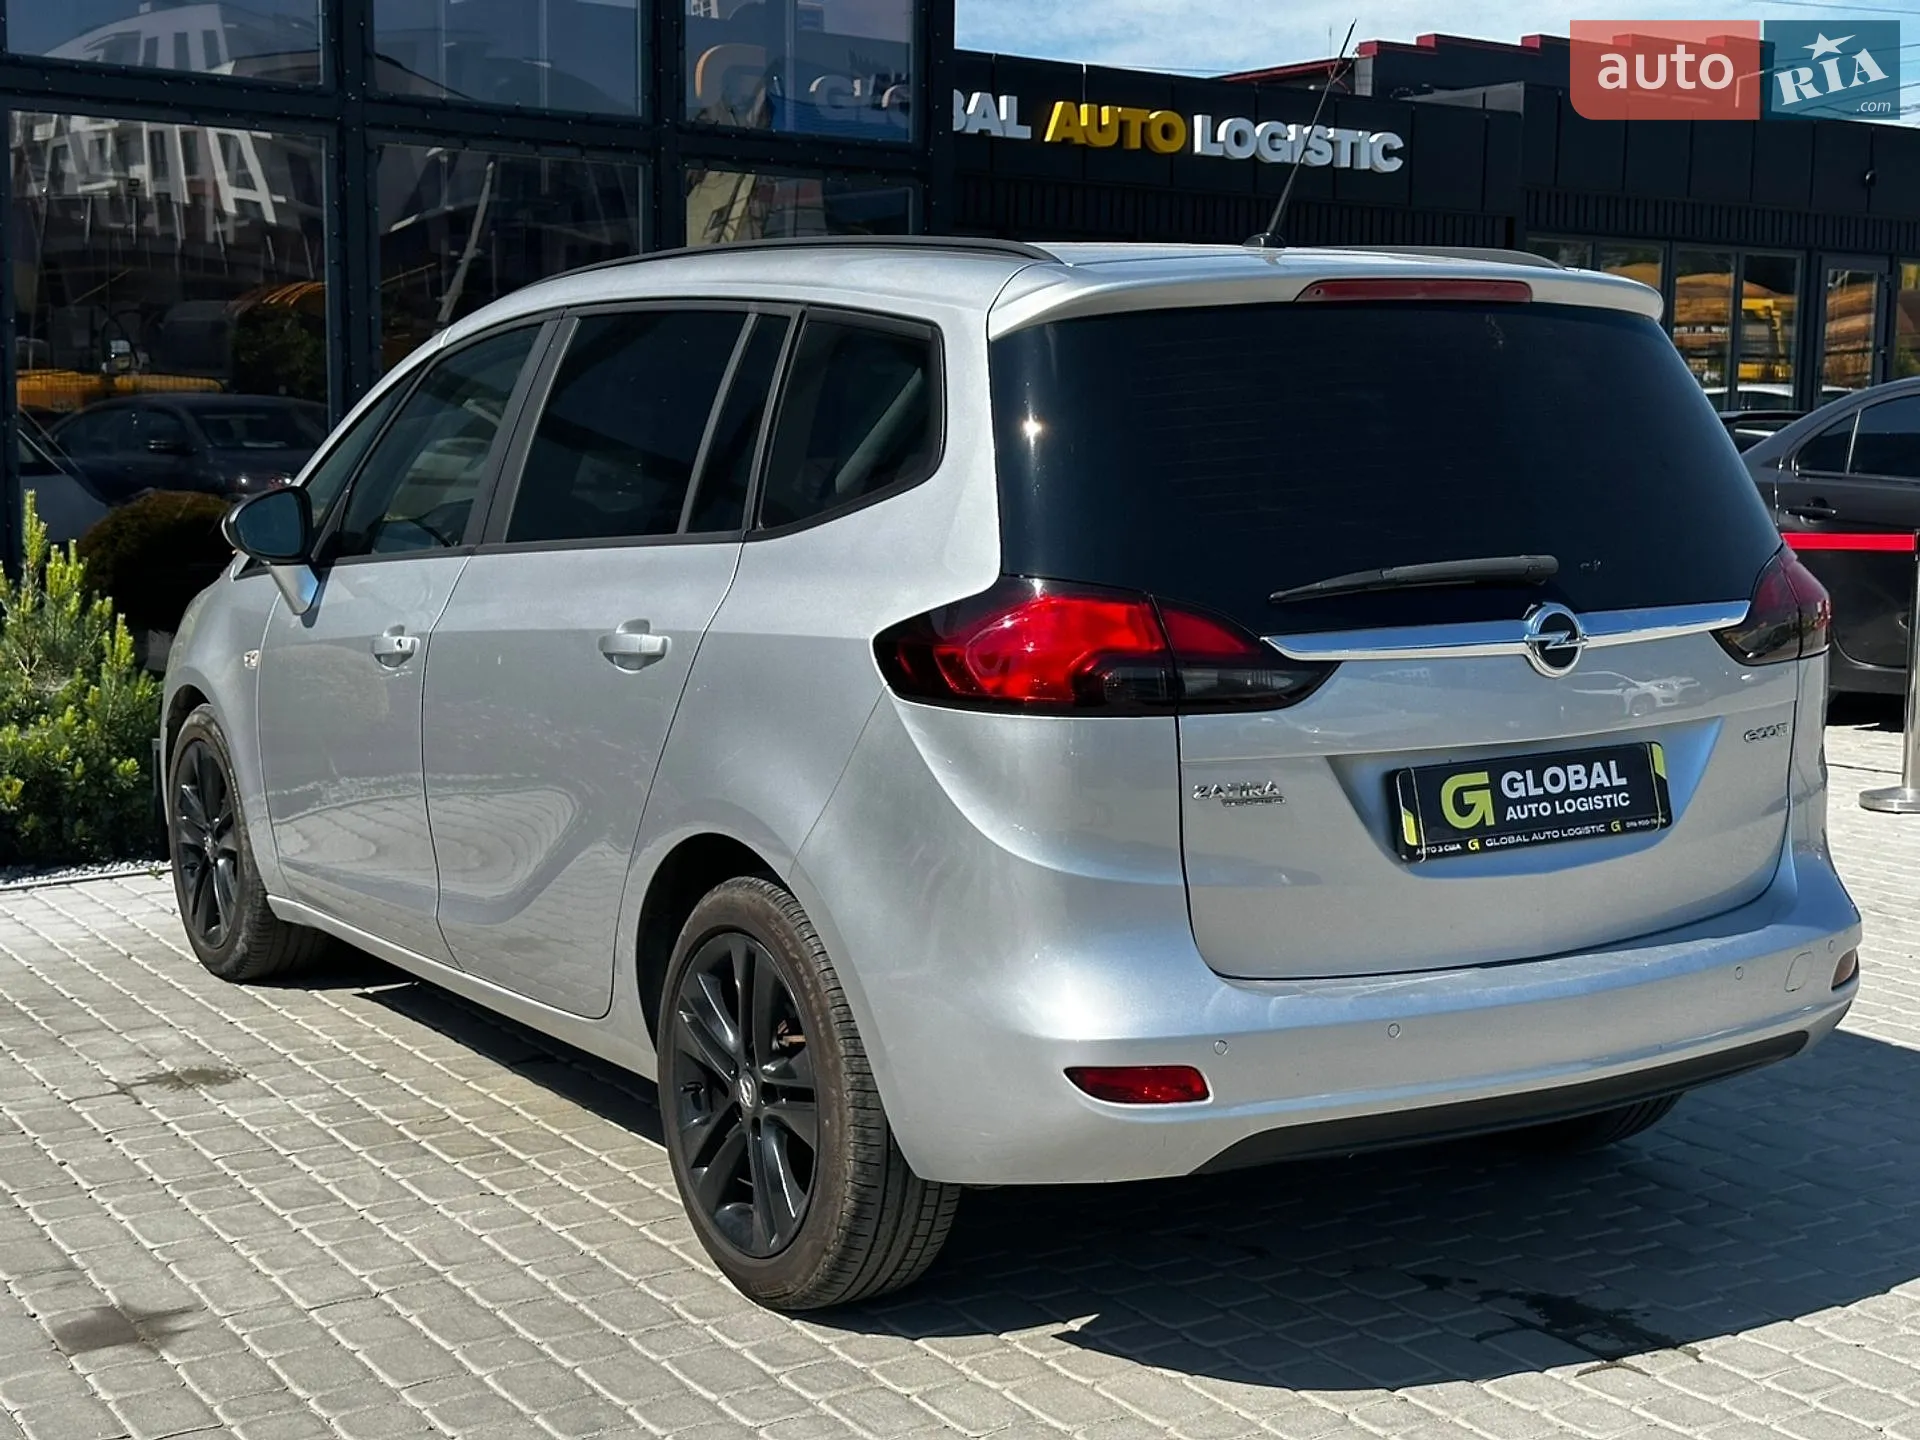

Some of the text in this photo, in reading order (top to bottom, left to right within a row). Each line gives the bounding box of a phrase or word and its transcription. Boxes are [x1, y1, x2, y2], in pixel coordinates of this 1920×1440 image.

[1043, 101, 1187, 154] AUTO
[1193, 114, 1404, 174] LOGISTIC
[1501, 760, 1628, 799] GLOBAL
[1505, 792, 1631, 821] AUTO LOGISTIC
[1485, 833, 1530, 847] GLOBAL
[1531, 829, 1560, 842] AUTO
[1561, 824, 1606, 838] LOGISTIC
